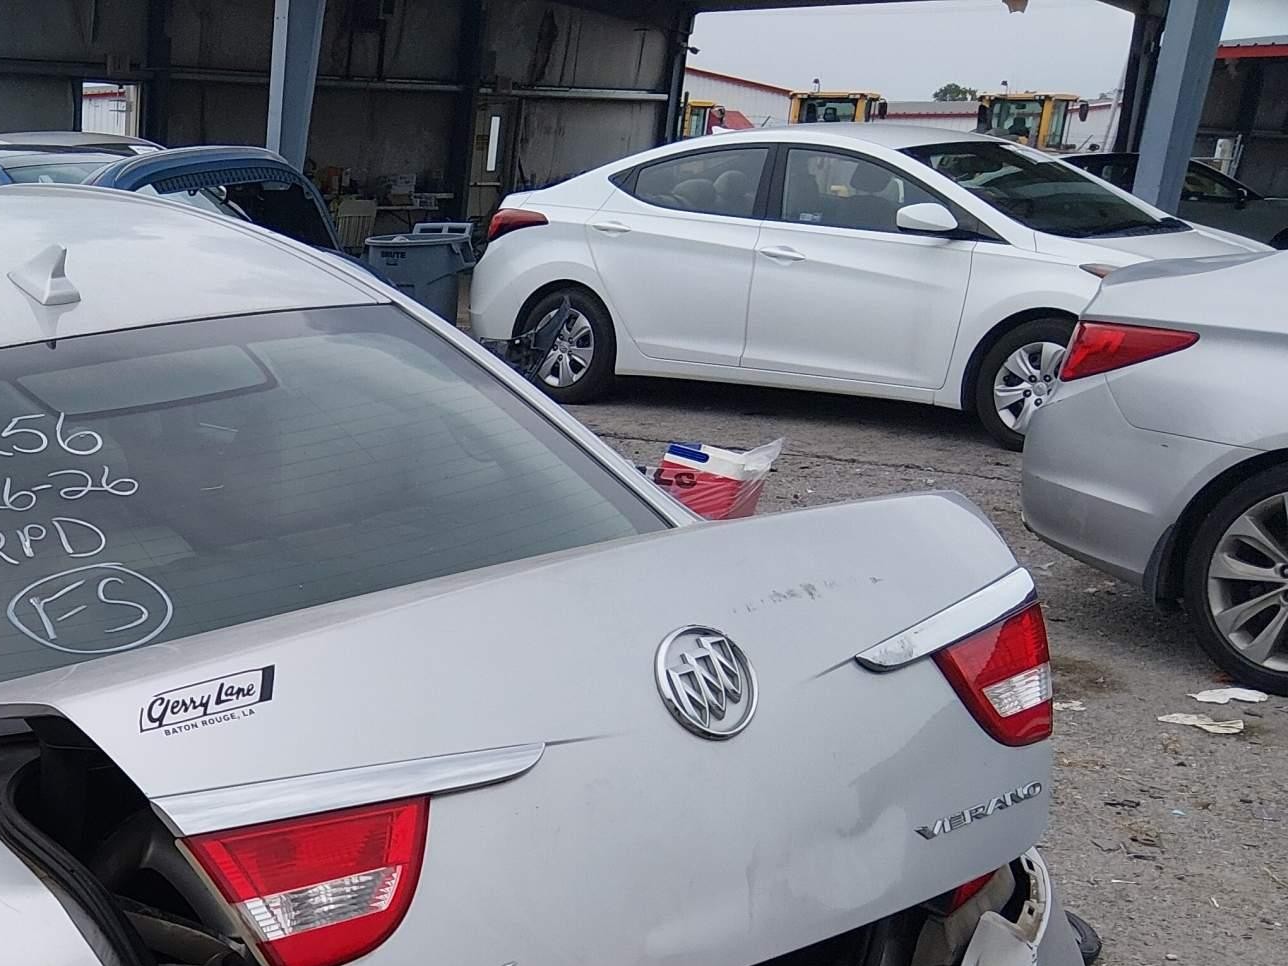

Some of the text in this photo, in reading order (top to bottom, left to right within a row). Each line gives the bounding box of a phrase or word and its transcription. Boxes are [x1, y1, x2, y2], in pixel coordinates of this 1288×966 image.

[29, 577, 149, 640] FS
[146, 682, 256, 728] Gerry Lane
[164, 708, 256, 737] BATON ROUGE, LA
[913, 781, 1042, 840] VERANO
